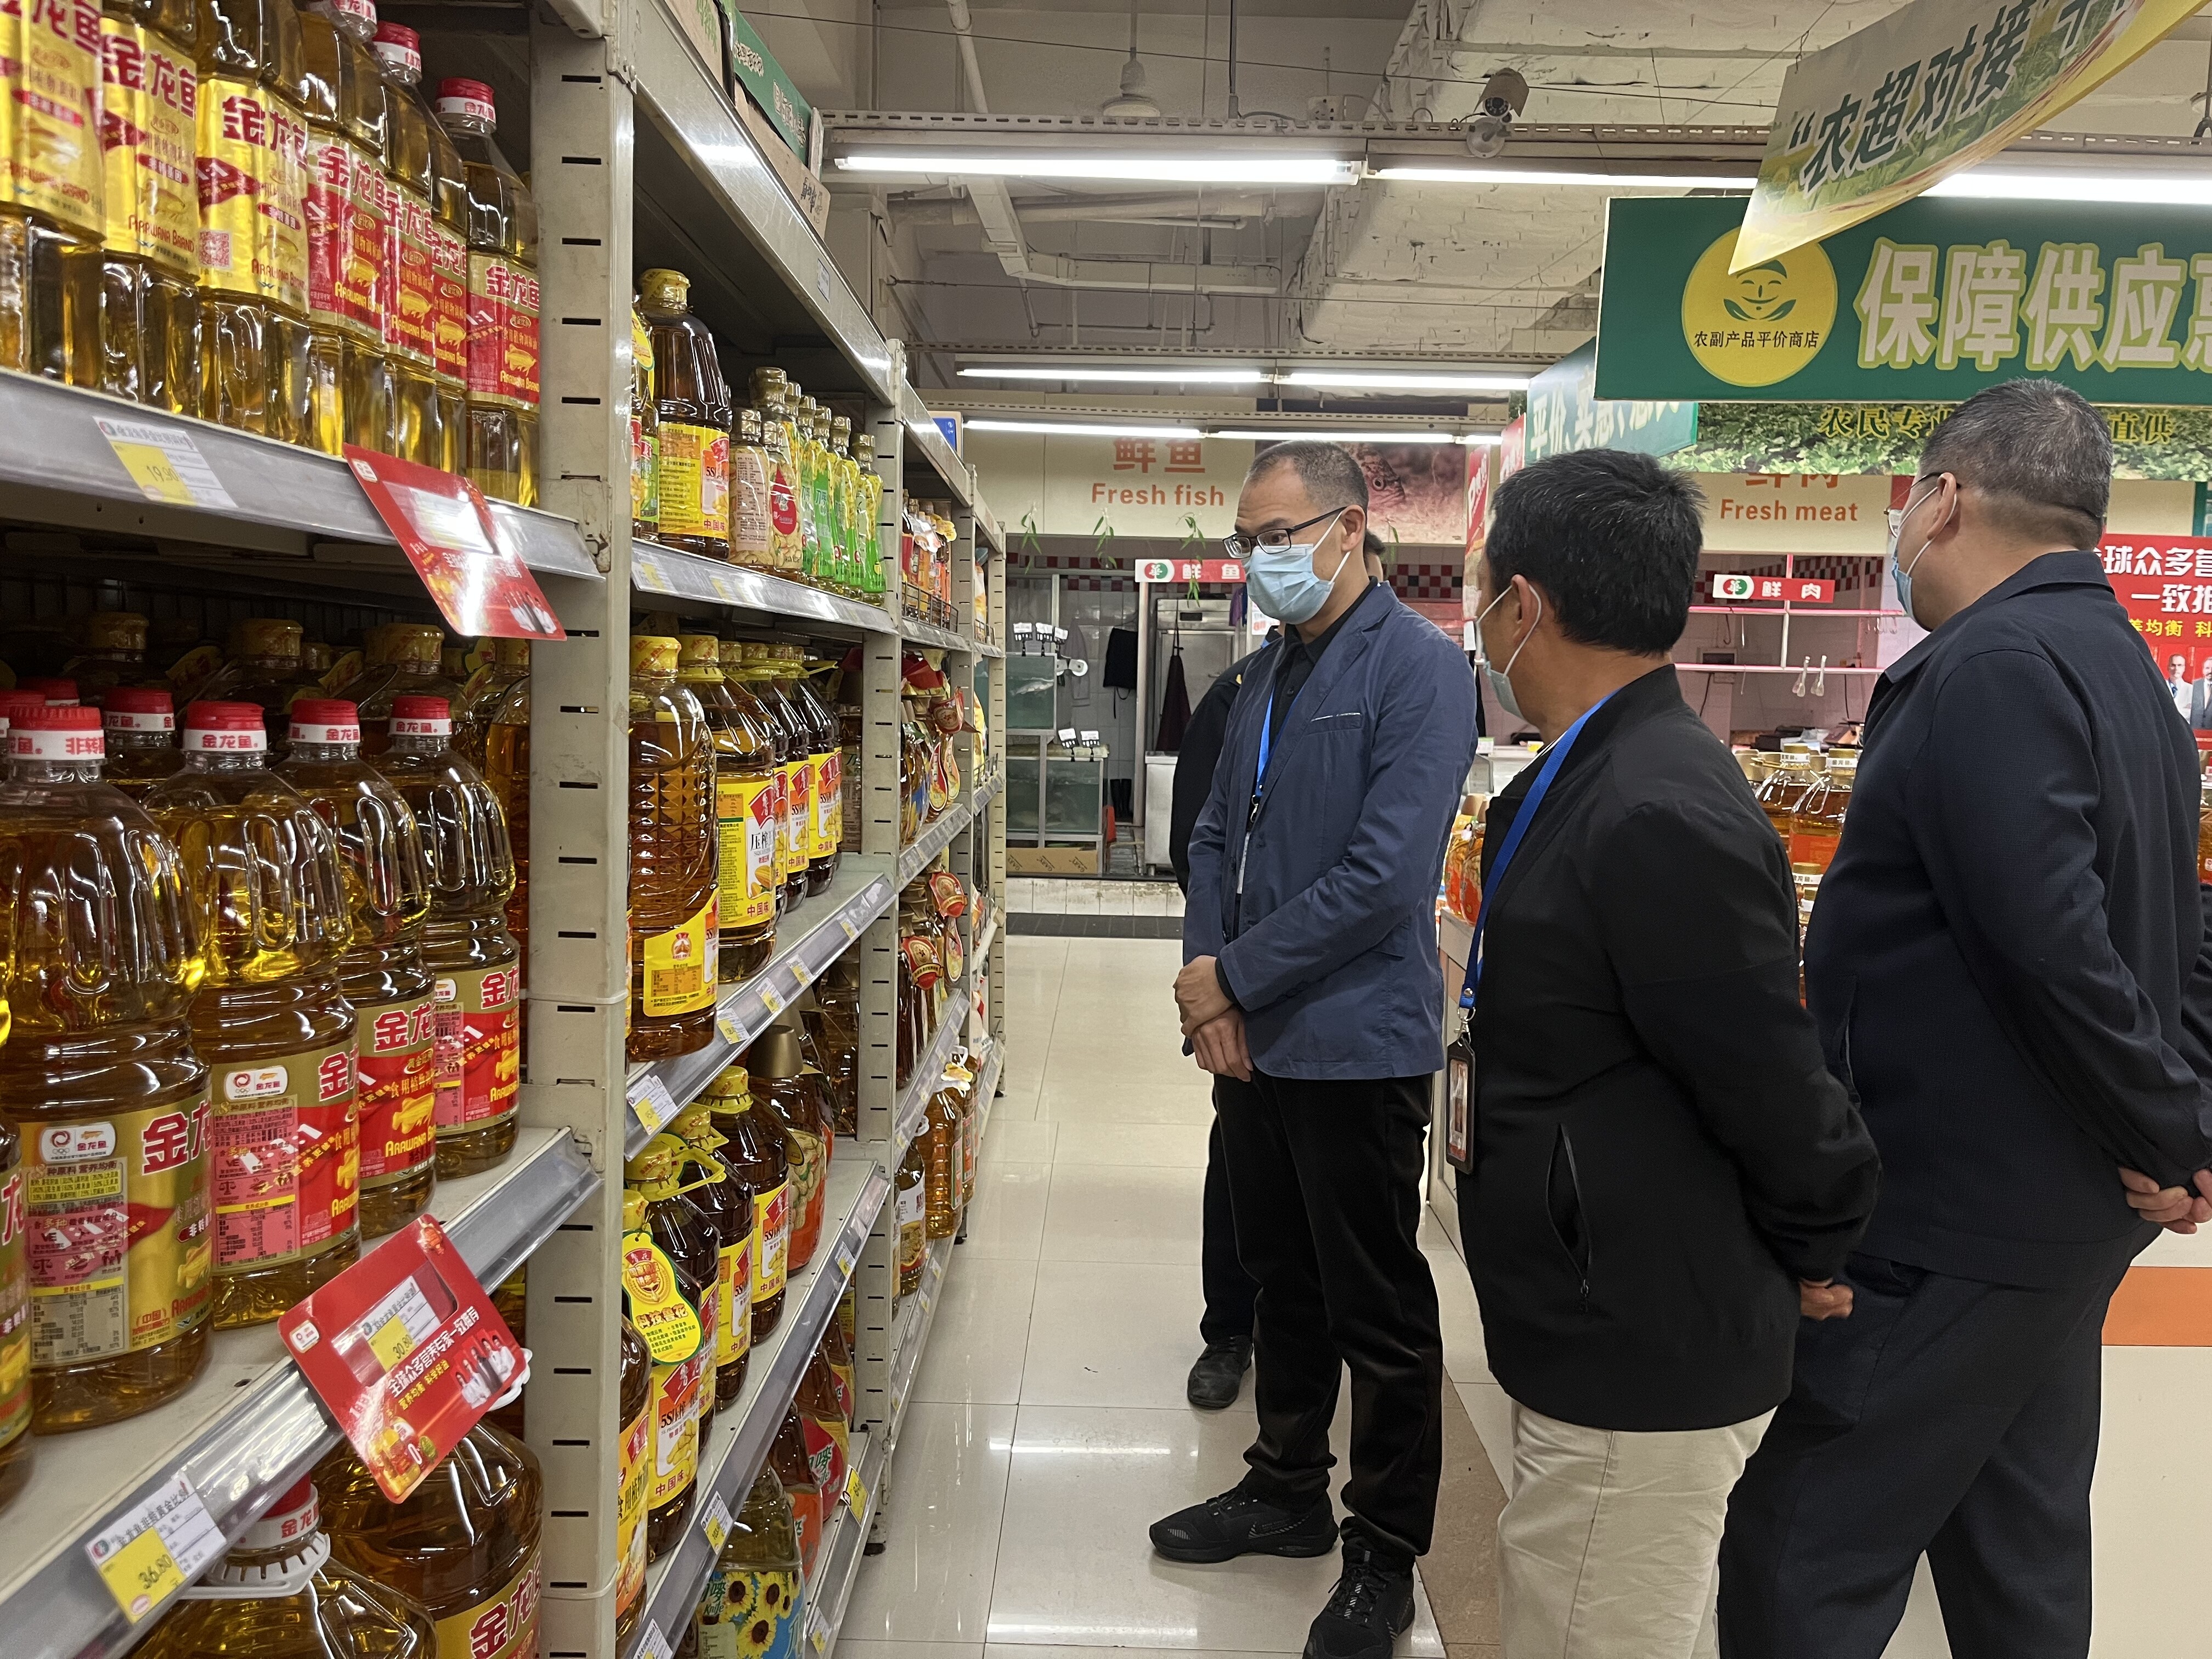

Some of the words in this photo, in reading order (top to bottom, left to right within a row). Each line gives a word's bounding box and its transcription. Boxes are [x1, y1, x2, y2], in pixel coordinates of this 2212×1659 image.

[0, 0, 101, 55] 龙鱼
[102, 34, 196, 121] 金龙鱼
[222, 95, 308, 172] 金龙鱼
[317, 145, 387, 215] 金龙鱼
[486, 266, 539, 312] 金龙鱼
[1693, 330, 1820, 348] 农副产品平价商店
[1113, 438, 1206, 473] 鲜鱼
[1092, 483, 1166, 505] Fresh
[1175, 484, 1226, 506] fish
[1720, 499, 1787, 521] Fresh
[1795, 503, 1859, 522] meat
[1182, 563, 1240, 579] 鲜鱼
[2094, 545, 2212, 577] 球众多营
[1761, 580, 1821, 600] 鲜肉
[396, 721, 432, 733] 金龙鱼
[202, 735, 253, 749] 金龙鱼
[788, 855, 806, 869] 中国味
[747, 900, 769, 918] 中国味
[374, 1003, 435, 1053] 金龙
[77, 1141, 108, 1152] 金龙鱼
[385, 1131, 427, 1158] ARAWANA
[78, 1160, 118, 1174] 营养均衡
[636, 1303, 689, 1329] 科技鲁花
[393, 1334, 413, 1359] 30.80
[655, 1469, 685, 1497] 中国味
[703, 1601, 724, 1616] Knife
